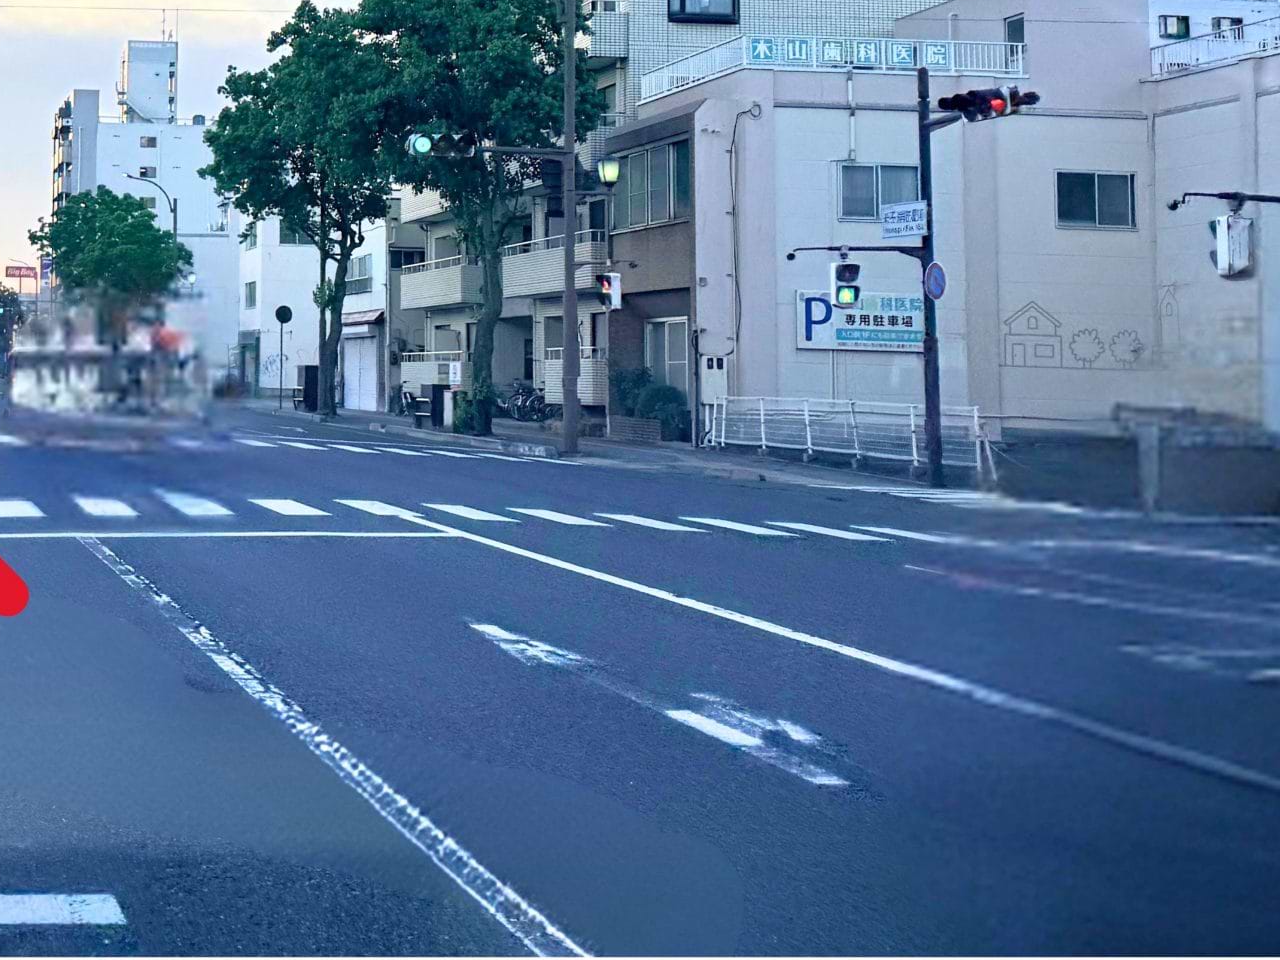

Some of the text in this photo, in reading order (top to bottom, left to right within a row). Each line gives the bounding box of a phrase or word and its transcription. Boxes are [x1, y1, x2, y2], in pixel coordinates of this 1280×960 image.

[753, 41, 946, 64] 木山歯科医院
[805, 297, 833, 341] P
[845, 314, 913, 327] 専用駐車場
